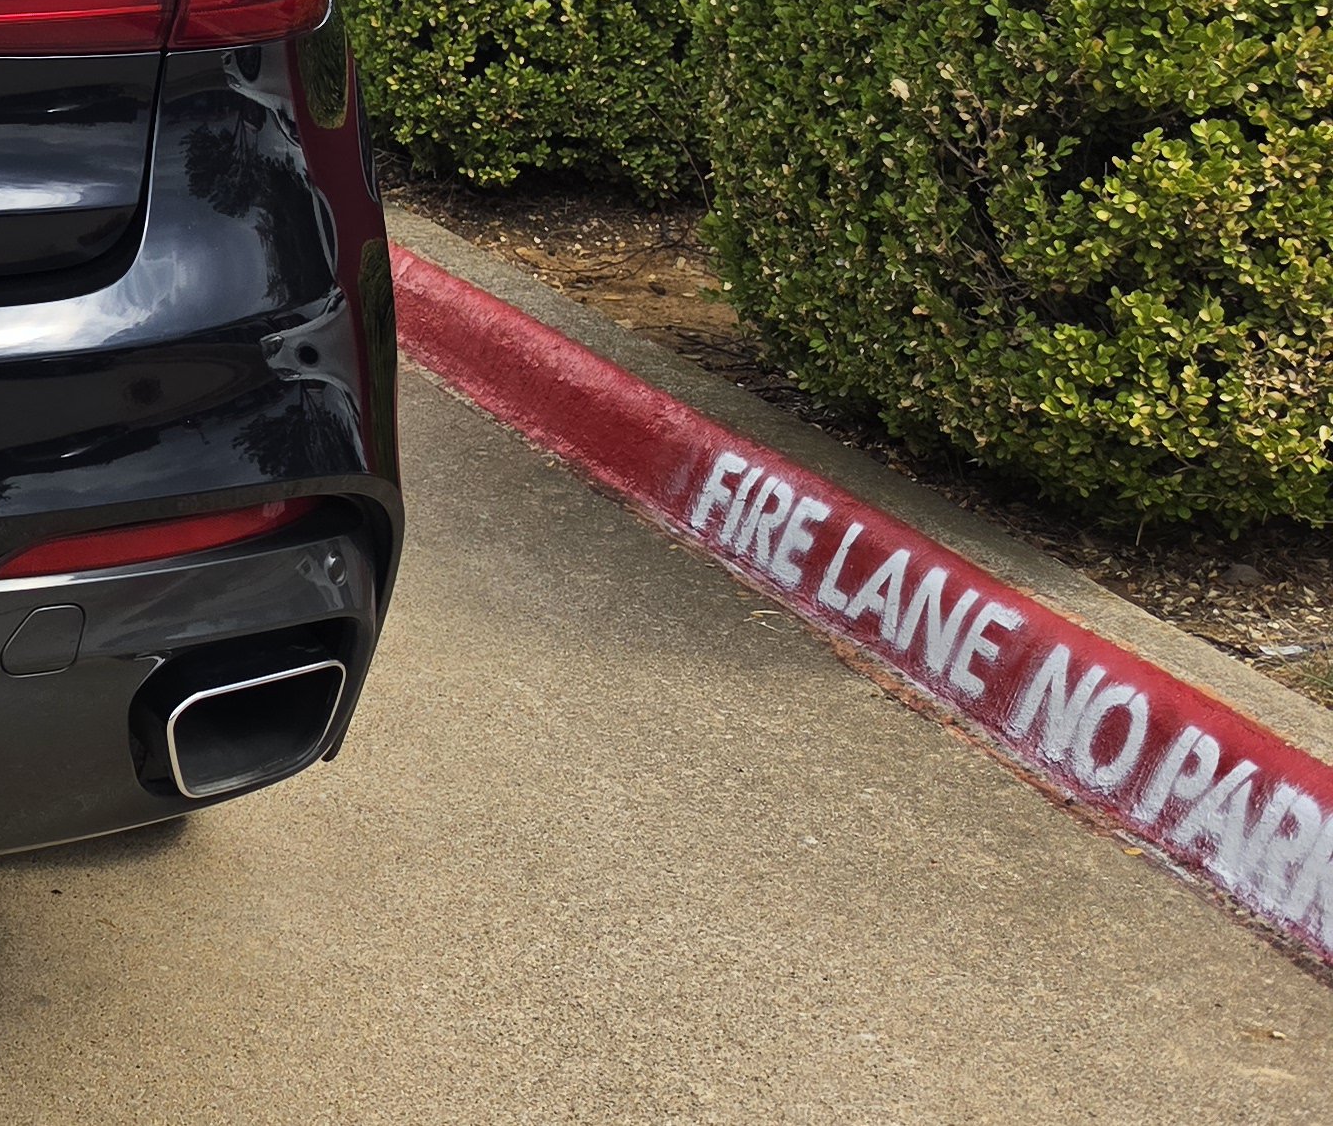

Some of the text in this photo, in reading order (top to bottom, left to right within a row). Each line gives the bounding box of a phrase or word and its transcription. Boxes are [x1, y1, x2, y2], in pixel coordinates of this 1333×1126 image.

[690, 451, 831, 592] FIRE
[817, 523, 1025, 699] LANE
[1010, 644, 1150, 796] NO
